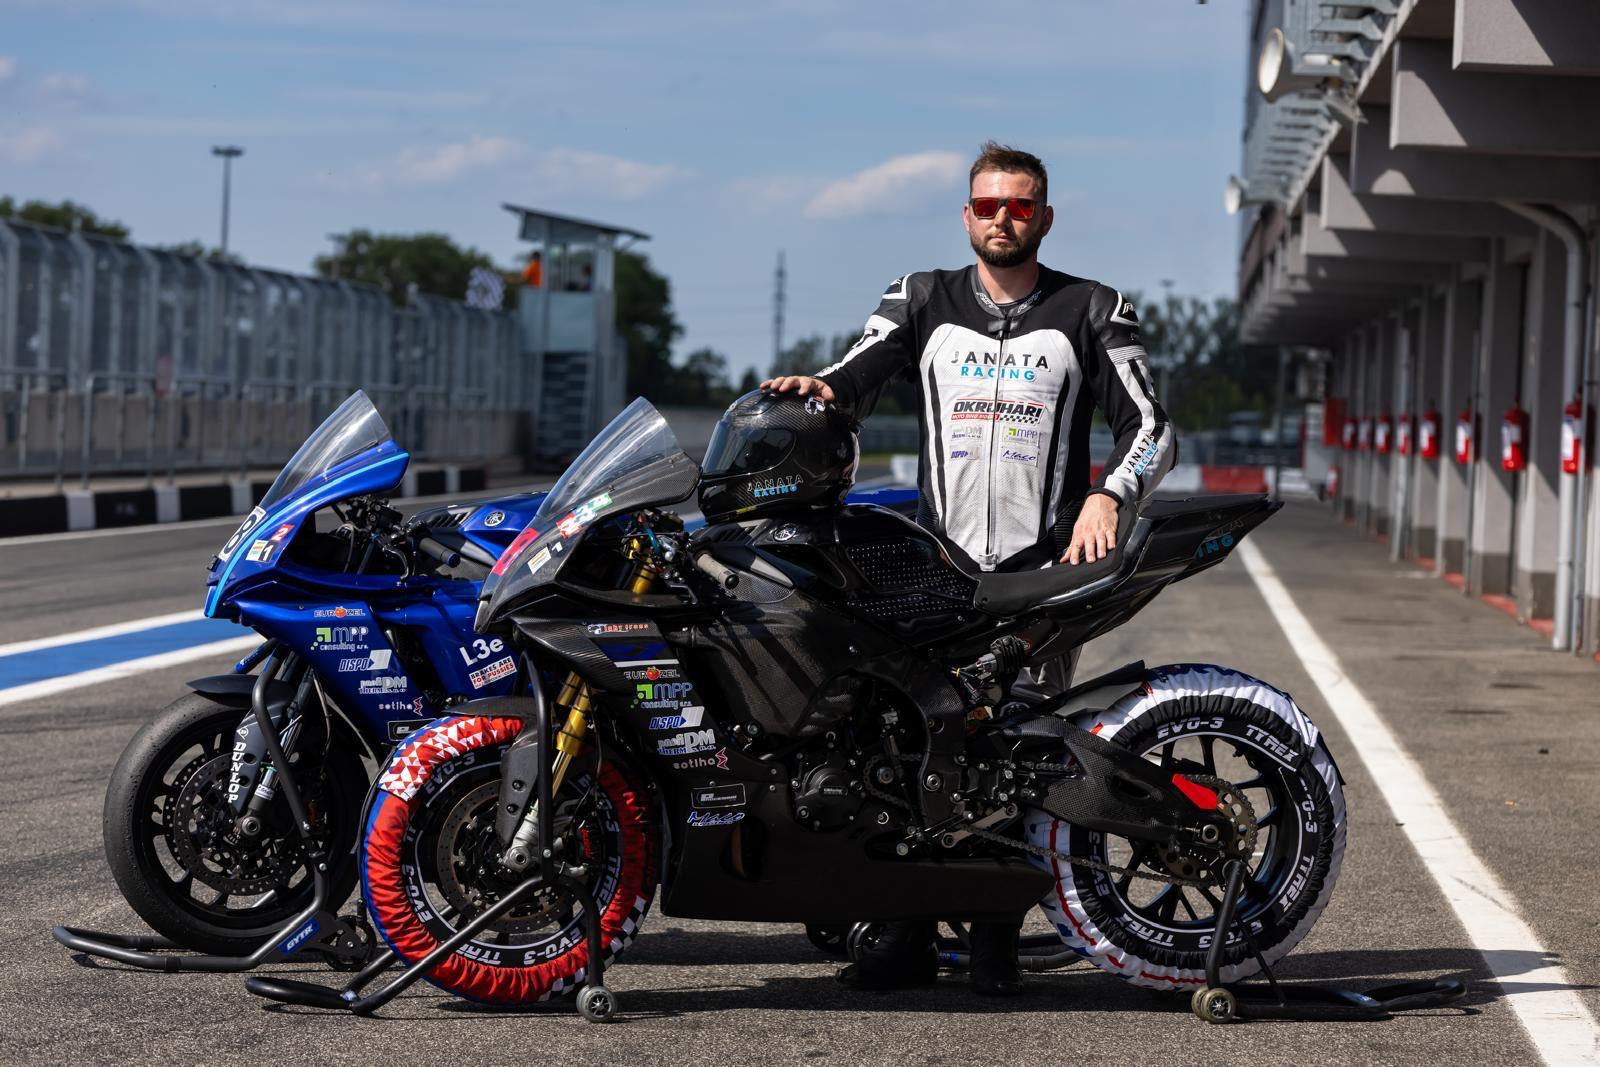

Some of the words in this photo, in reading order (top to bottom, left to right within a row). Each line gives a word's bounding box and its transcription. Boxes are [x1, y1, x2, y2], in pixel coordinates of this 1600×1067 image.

[951, 351, 1050, 370] JANATA
[961, 366, 1036, 382] RACING
[953, 401, 1043, 418] OKRUHARI
[747, 474, 803, 492] JANATA
[270, 526, 289, 542] 2
[262, 544, 274, 561] 1
[459, 638, 504, 667] L3e
[339, 657, 370, 672] DISPO
[470, 663, 497, 680] BRAKES
[498, 657, 512, 668] ARE
[473, 675, 486, 685] FOR
[487, 662, 514, 679] PUSSIES
[649, 715, 681, 730] DISPO
[1157, 716, 1225, 740] EVO-3
[1246, 723, 1300, 763] TYREX
[228, 741, 246, 804] DUNLOP
[401, 863, 434, 923] EVO-3
[1278, 854, 1315, 913] TYREX
[455, 943, 502, 966] TYR
[523, 926, 584, 966] EVO-3
